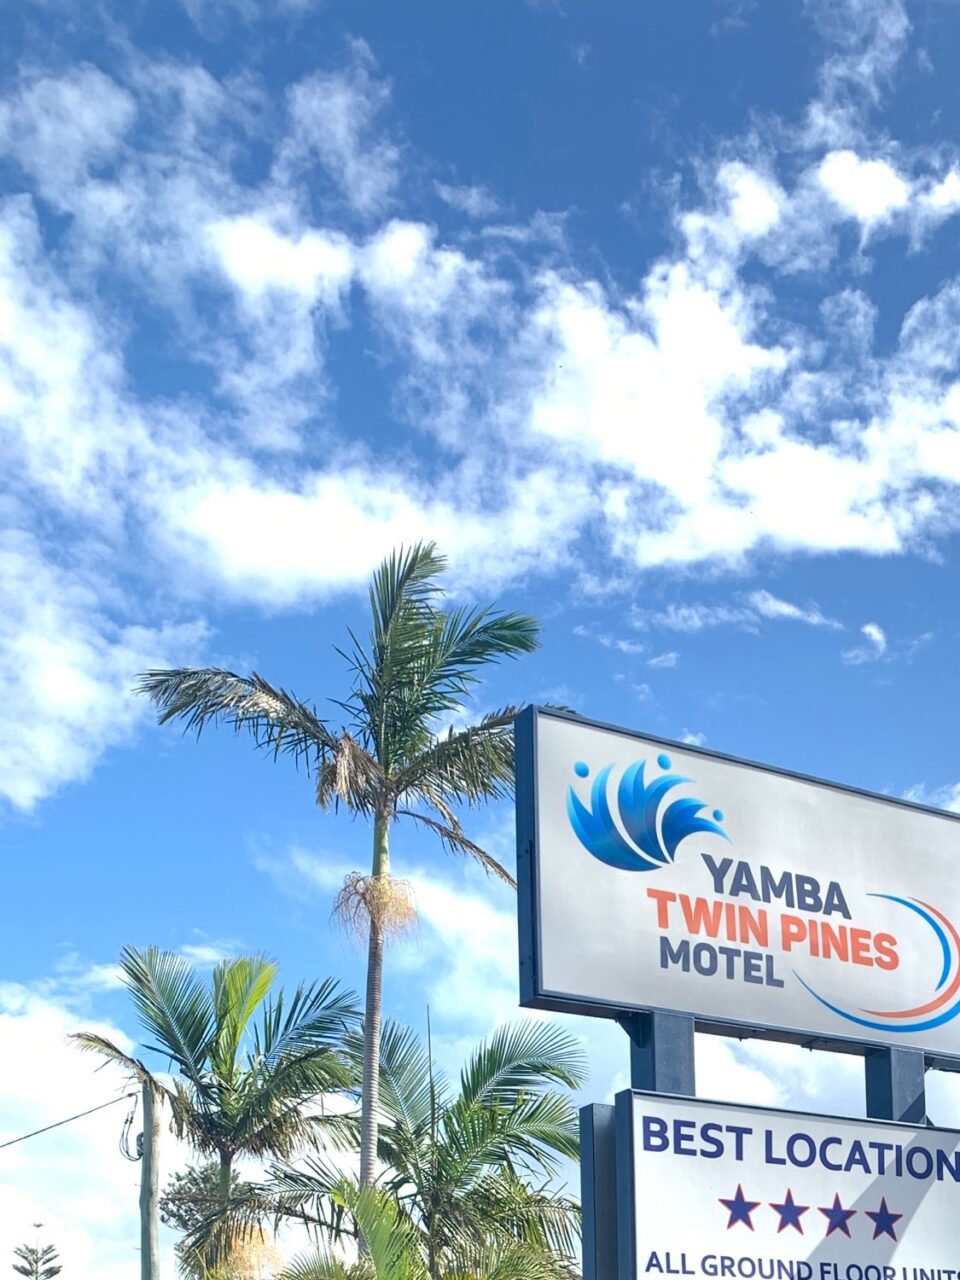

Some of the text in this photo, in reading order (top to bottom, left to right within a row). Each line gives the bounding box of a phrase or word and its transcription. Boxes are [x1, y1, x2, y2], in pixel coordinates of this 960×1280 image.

[701, 853, 852, 920] YAMBA
[647, 888, 900, 971] TWIN PINES
[659, 936, 784, 988] MOTEL
[642, 1116, 752, 1161] BEST
[645, 1251, 695, 1275] ALL
